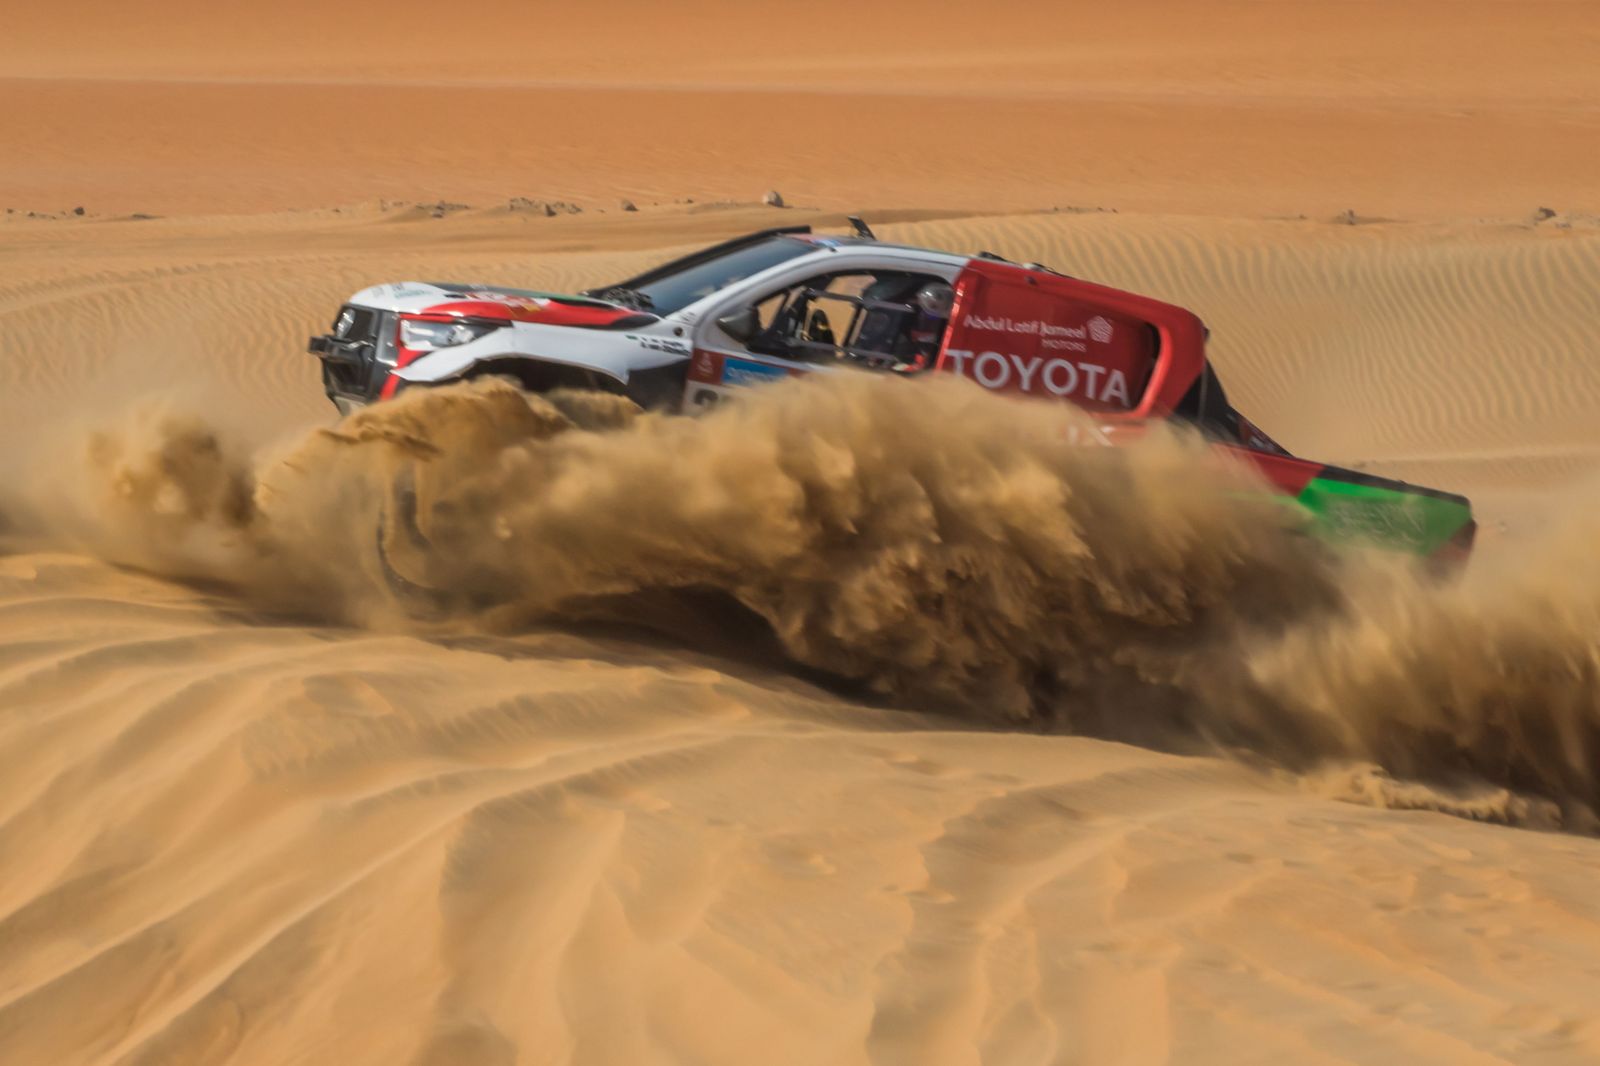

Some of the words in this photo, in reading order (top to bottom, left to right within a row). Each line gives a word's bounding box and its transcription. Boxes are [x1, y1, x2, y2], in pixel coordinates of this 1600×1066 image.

[963, 314, 1005, 331] Abdul
[1006, 317, 1039, 334] Latif
[1039, 320, 1088, 339] Jameel
[944, 348, 1131, 409] TOYOTA
